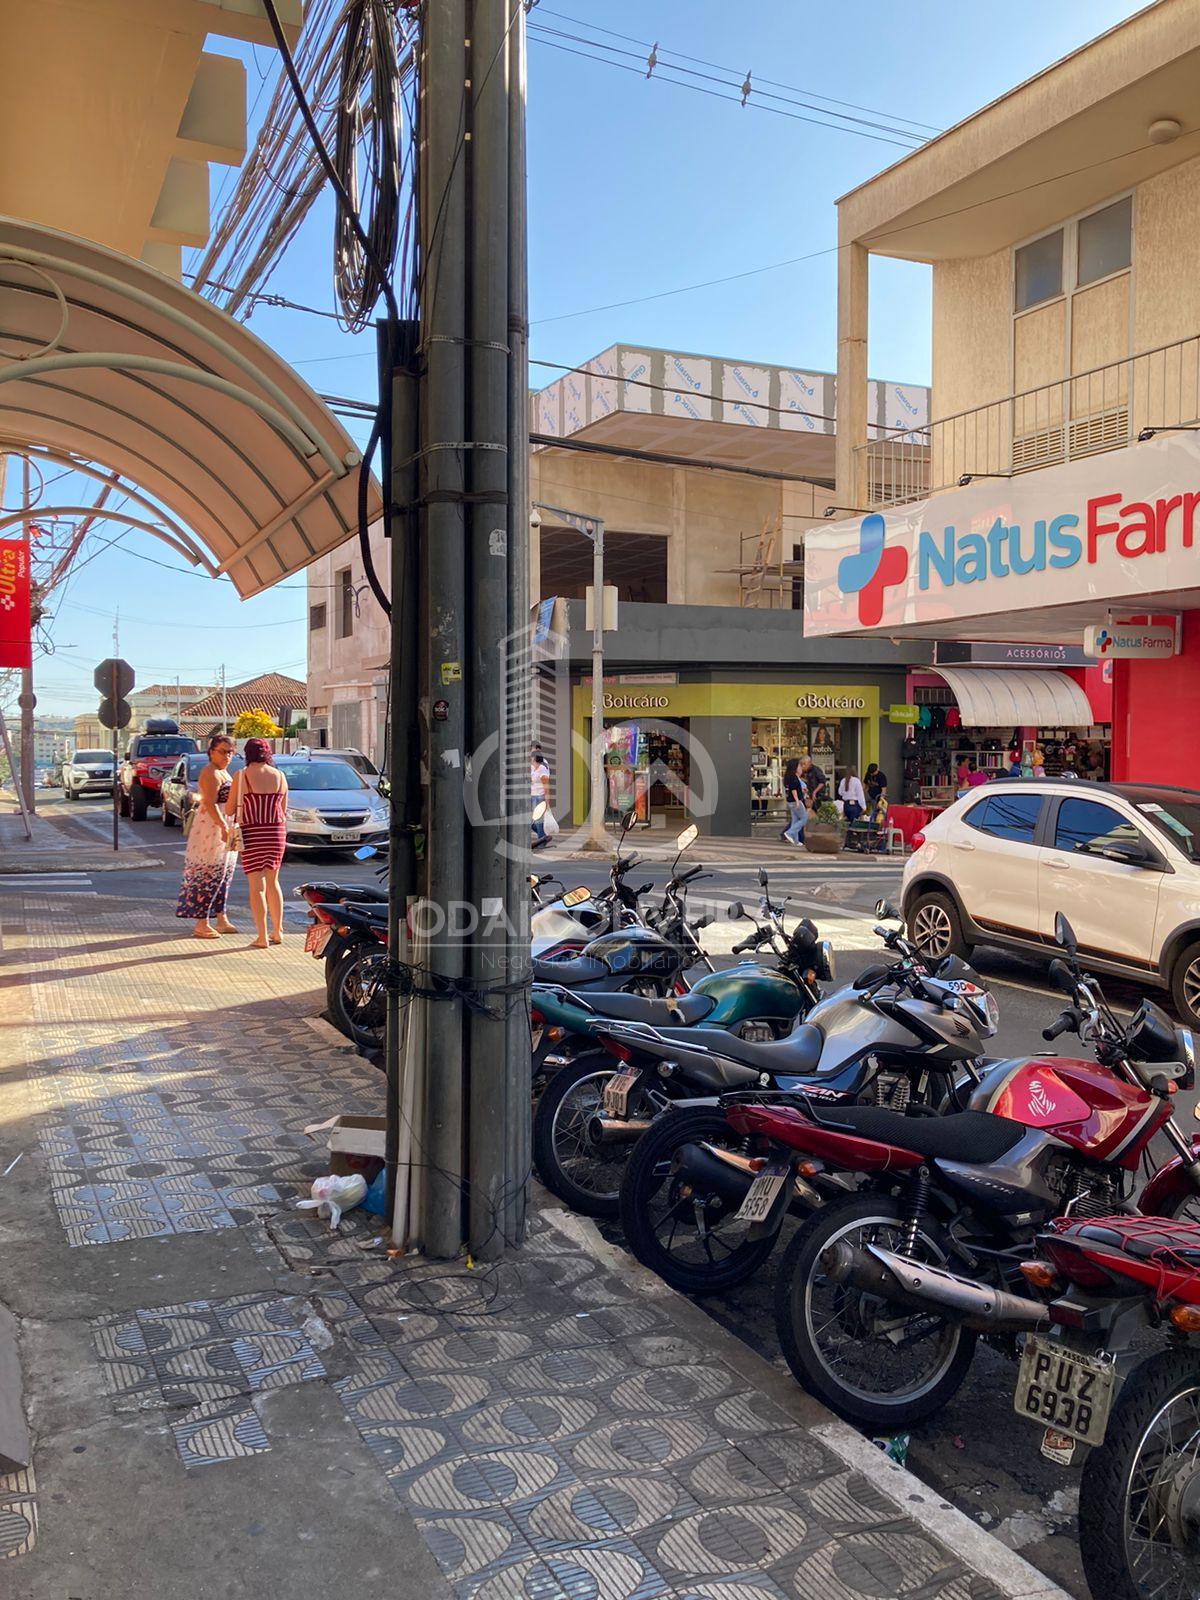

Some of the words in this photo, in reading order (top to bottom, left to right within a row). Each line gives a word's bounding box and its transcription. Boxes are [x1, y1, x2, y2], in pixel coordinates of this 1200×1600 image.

[0, 549, 16, 595] Ultra
[1112, 632, 1172, 649] NatusFarma
[1033, 1353, 1097, 1403] PUZ
[1026, 1384, 1093, 1436] 6938
